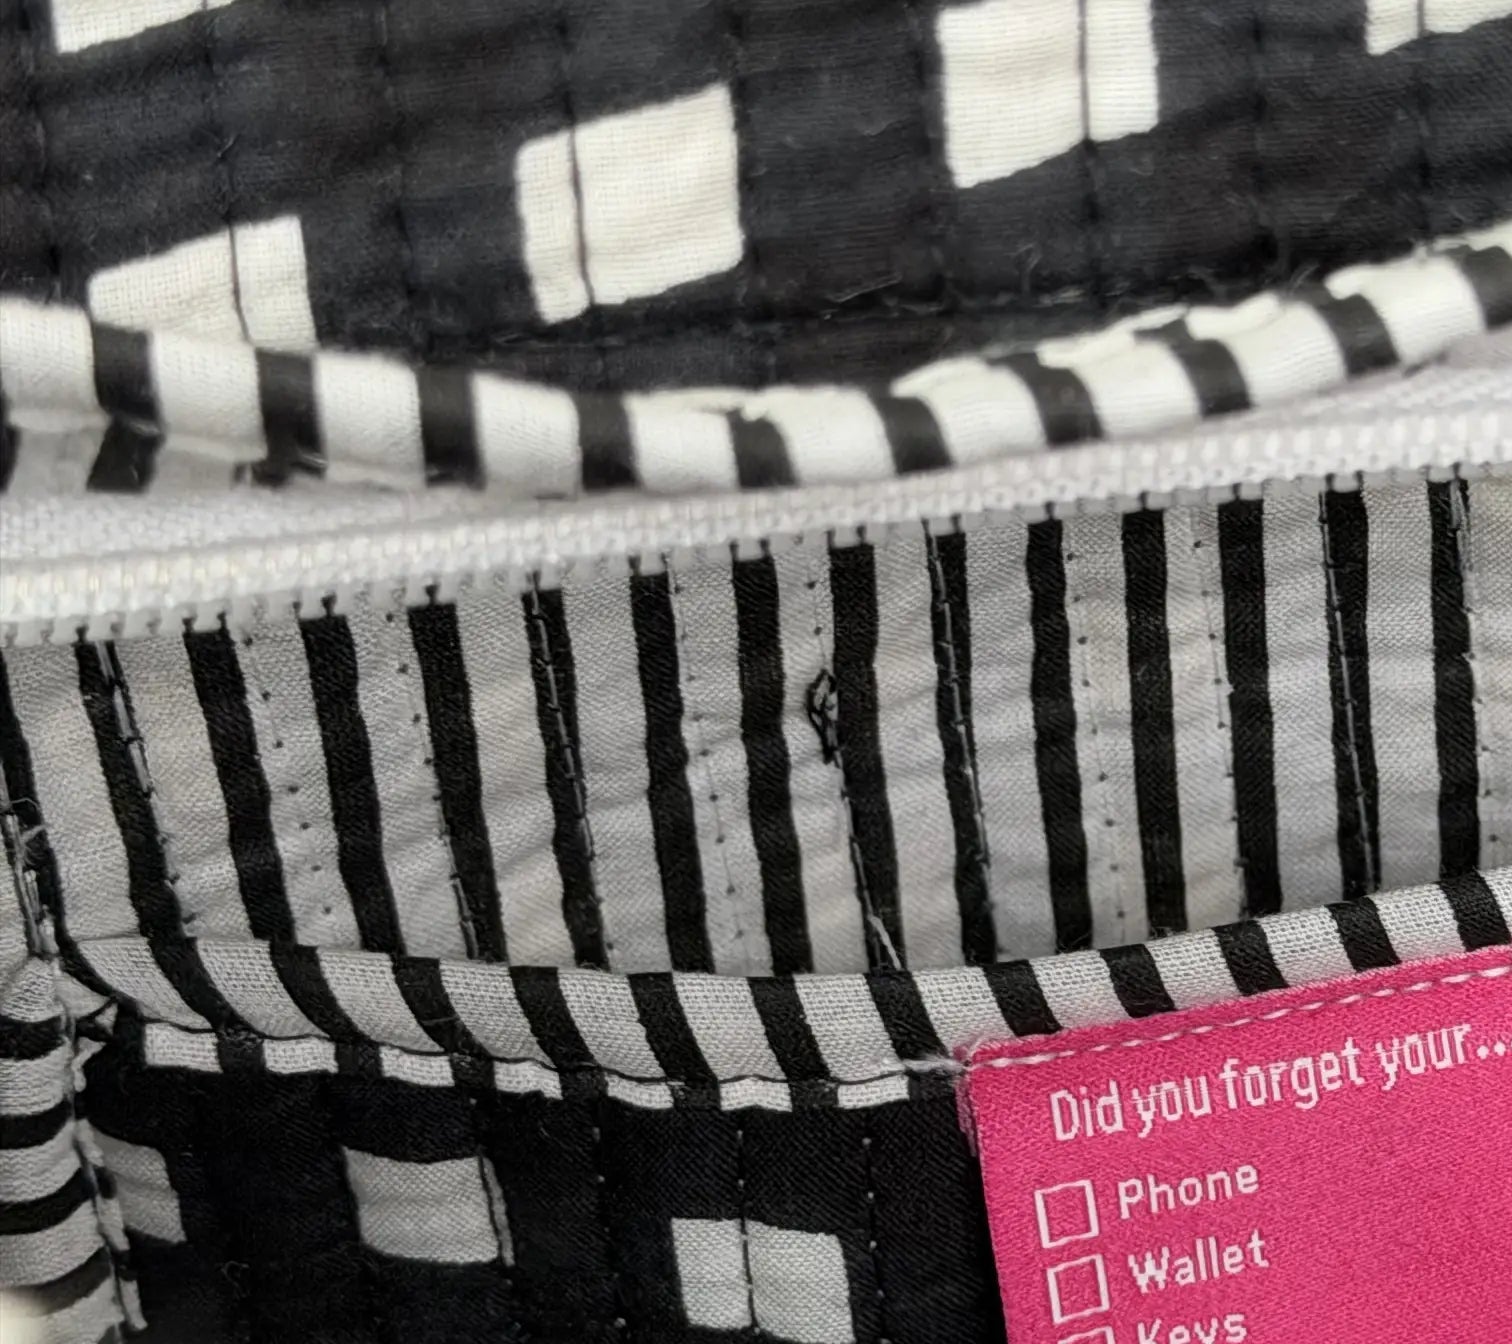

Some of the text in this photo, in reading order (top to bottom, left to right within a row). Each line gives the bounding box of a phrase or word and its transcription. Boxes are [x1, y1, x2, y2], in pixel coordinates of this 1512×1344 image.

[1052, 1081, 1122, 1142] Did
[1132, 1076, 1210, 1137] you
[1220, 1040, 1366, 1111] forget
[1118, 1164, 1259, 1218] Phone
[1129, 1230, 1270, 1292] Wallet
